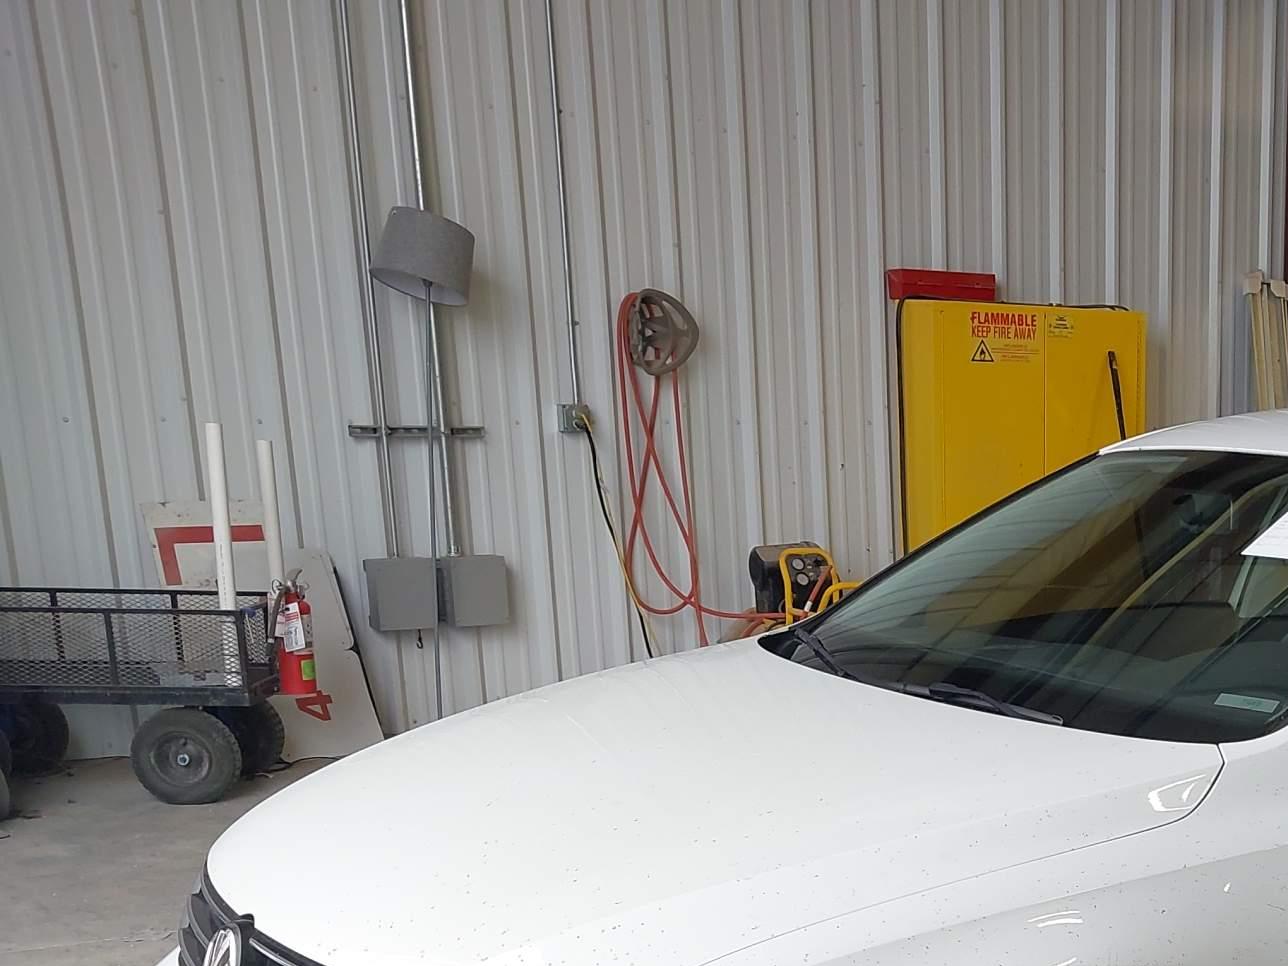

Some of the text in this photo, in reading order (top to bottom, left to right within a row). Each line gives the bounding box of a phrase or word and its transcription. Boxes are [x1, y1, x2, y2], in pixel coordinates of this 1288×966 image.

[970, 311, 1037, 327] FLAMMABLE
[971, 325, 1037, 341] KEEP FIRE AWAY
